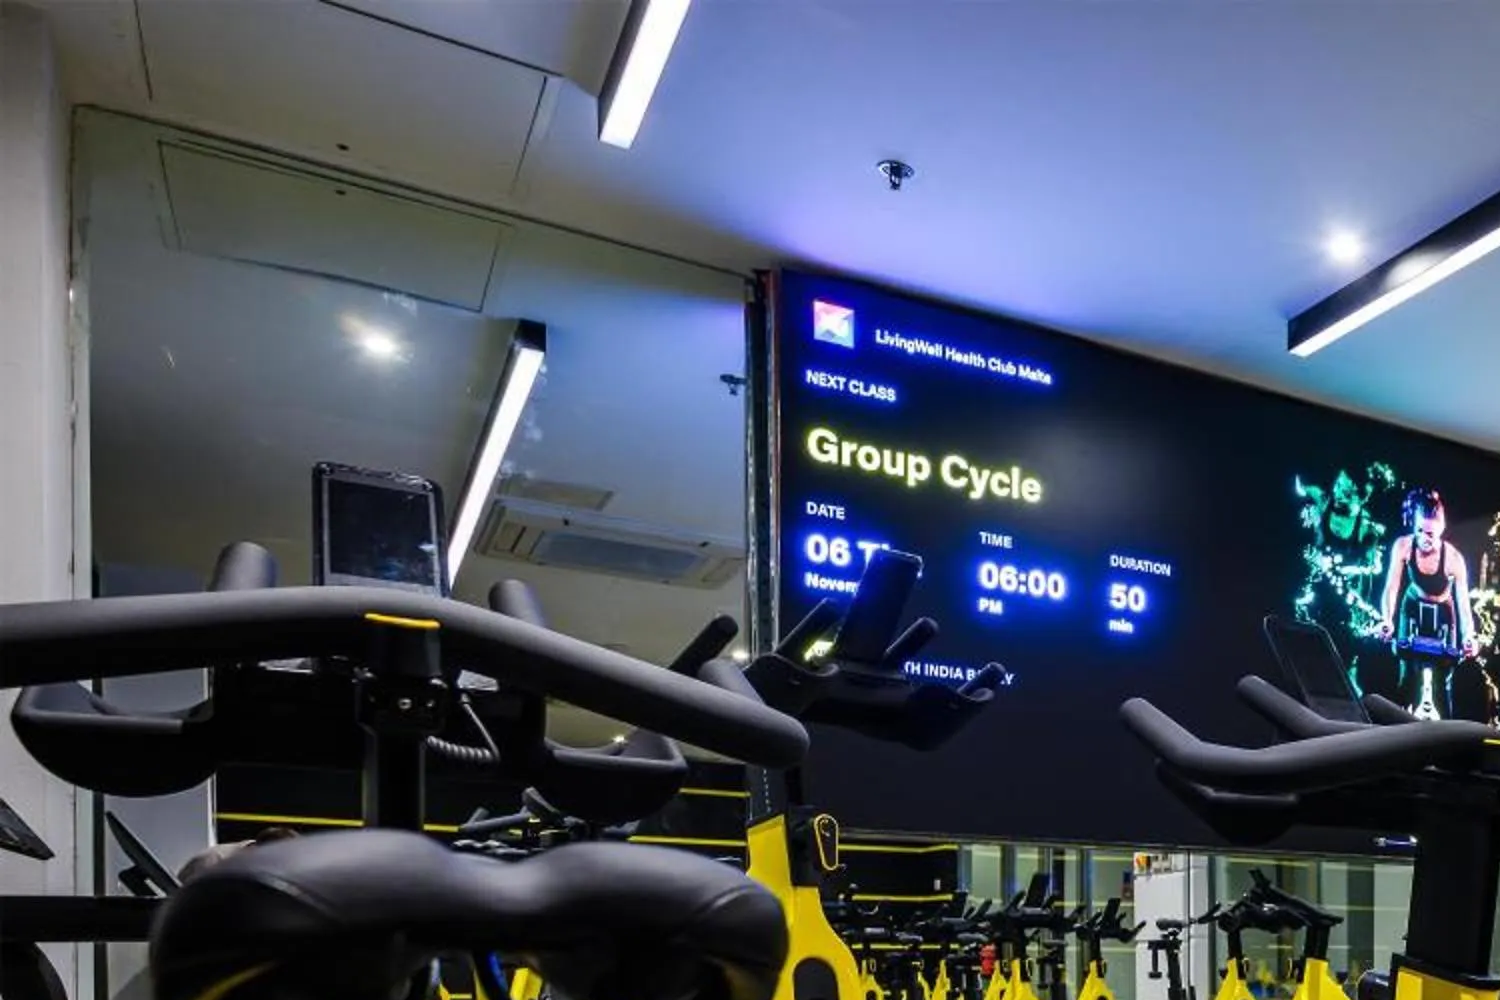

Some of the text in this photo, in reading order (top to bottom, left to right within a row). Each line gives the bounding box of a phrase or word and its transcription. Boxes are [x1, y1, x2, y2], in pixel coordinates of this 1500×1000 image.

[875, 328, 1052, 385] LivingWell Health Club Malta
[806, 369, 897, 402] NEXT CLASS
[806, 427, 1043, 504] Group Cycle
[806, 501, 846, 521] DATE
[805, 533, 852, 567] 06
[979, 531, 1013, 549] TIME
[1109, 554, 1172, 577] DURATION
[804, 571, 859, 594] Novem
[978, 561, 1066, 599] 06:00
[978, 597, 1004, 614] PM
[1109, 582, 1146, 613] 50
[1109, 617, 1133, 634] min
[924, 663, 964, 681] INDIA
